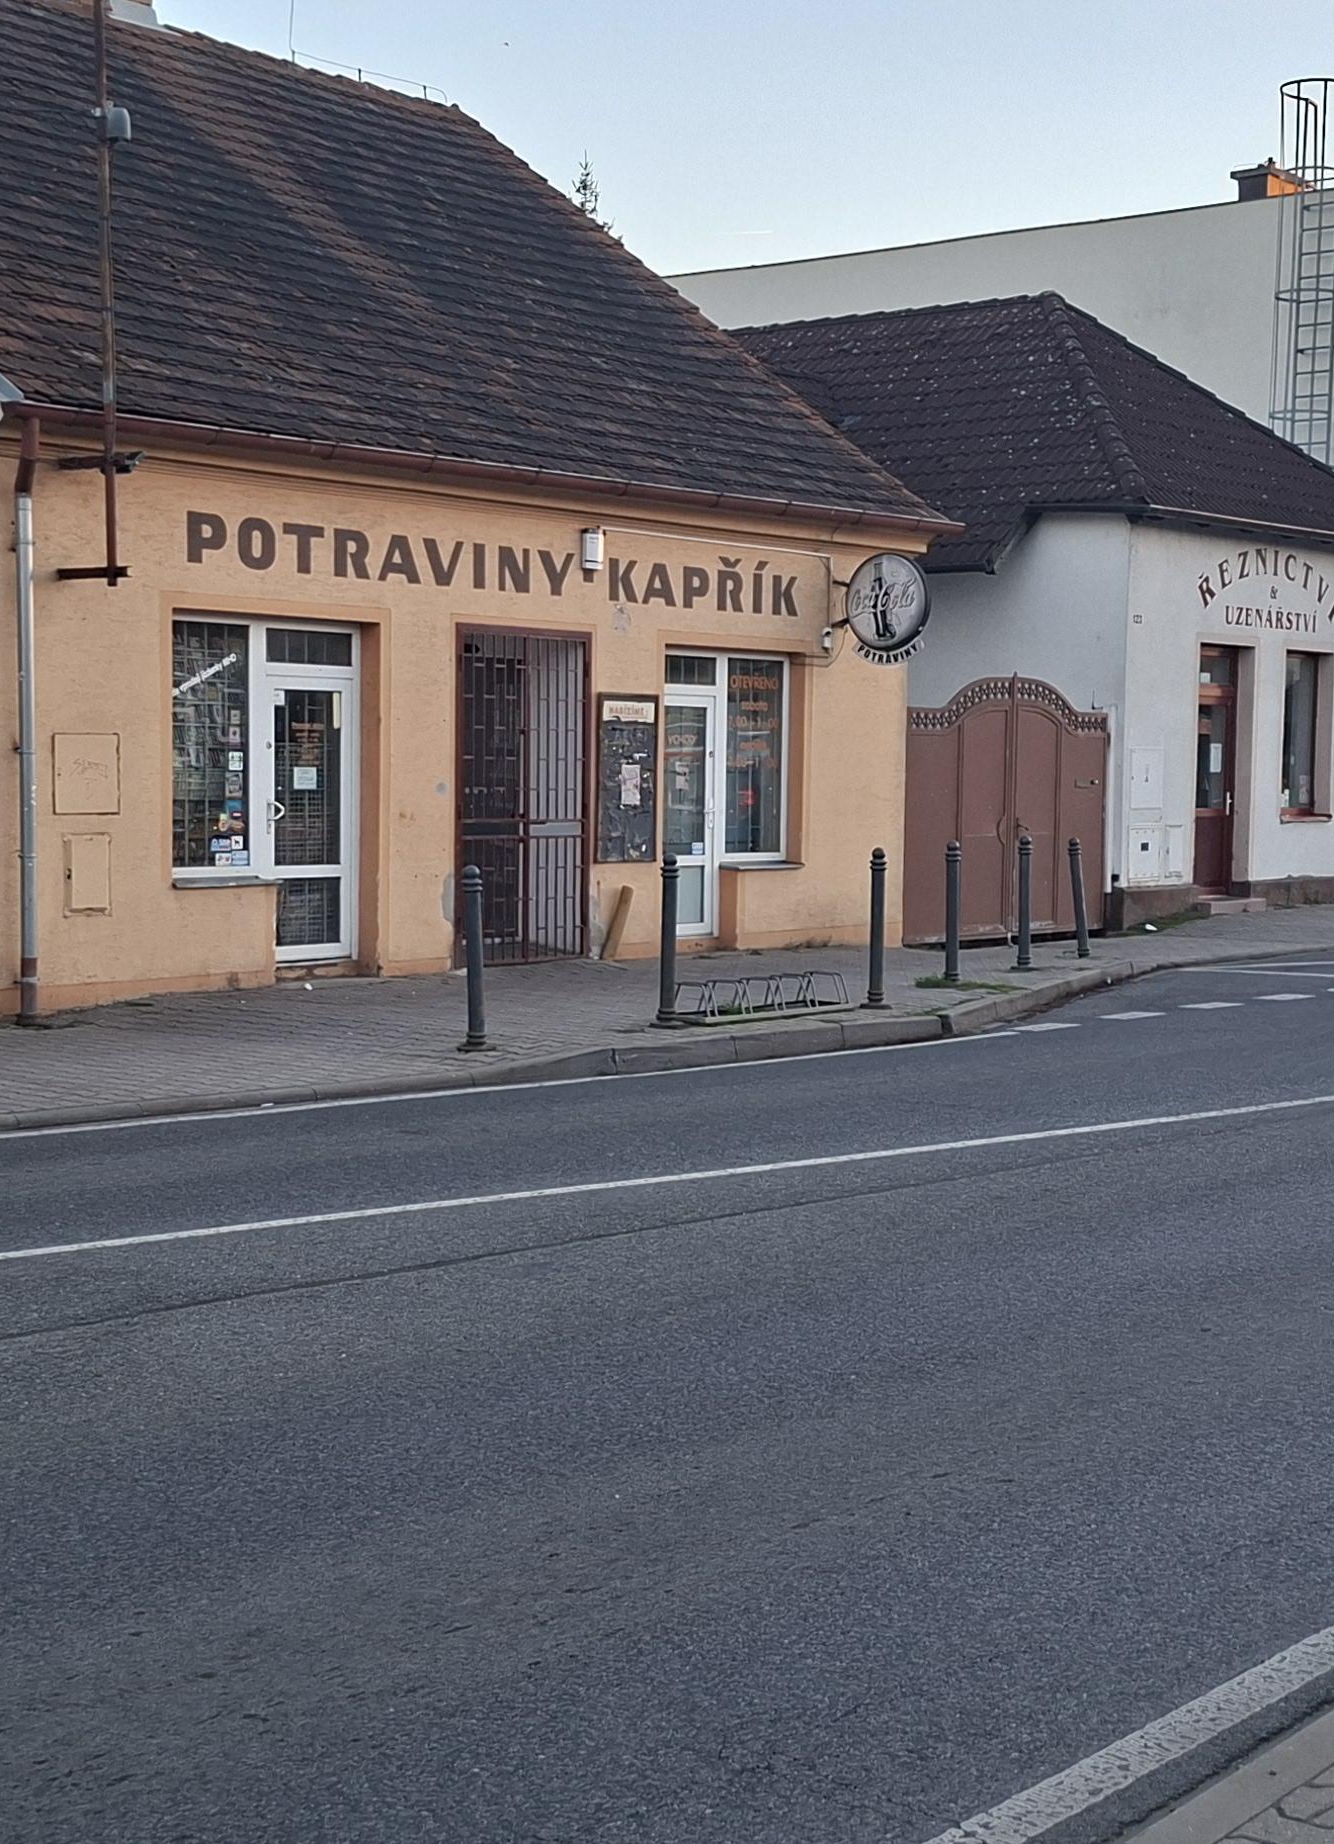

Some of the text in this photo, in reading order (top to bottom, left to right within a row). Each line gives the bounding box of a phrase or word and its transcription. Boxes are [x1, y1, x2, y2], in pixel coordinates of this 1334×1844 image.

[186, 510, 576, 597] POTRAVINY
[608, 556, 799, 617] KAPŘÍK
[1269, 585, 1280, 600] &
[1225, 604, 1319, 634] UZENÁŘSTVÍ
[857, 643, 918, 664] POTRAVINY
